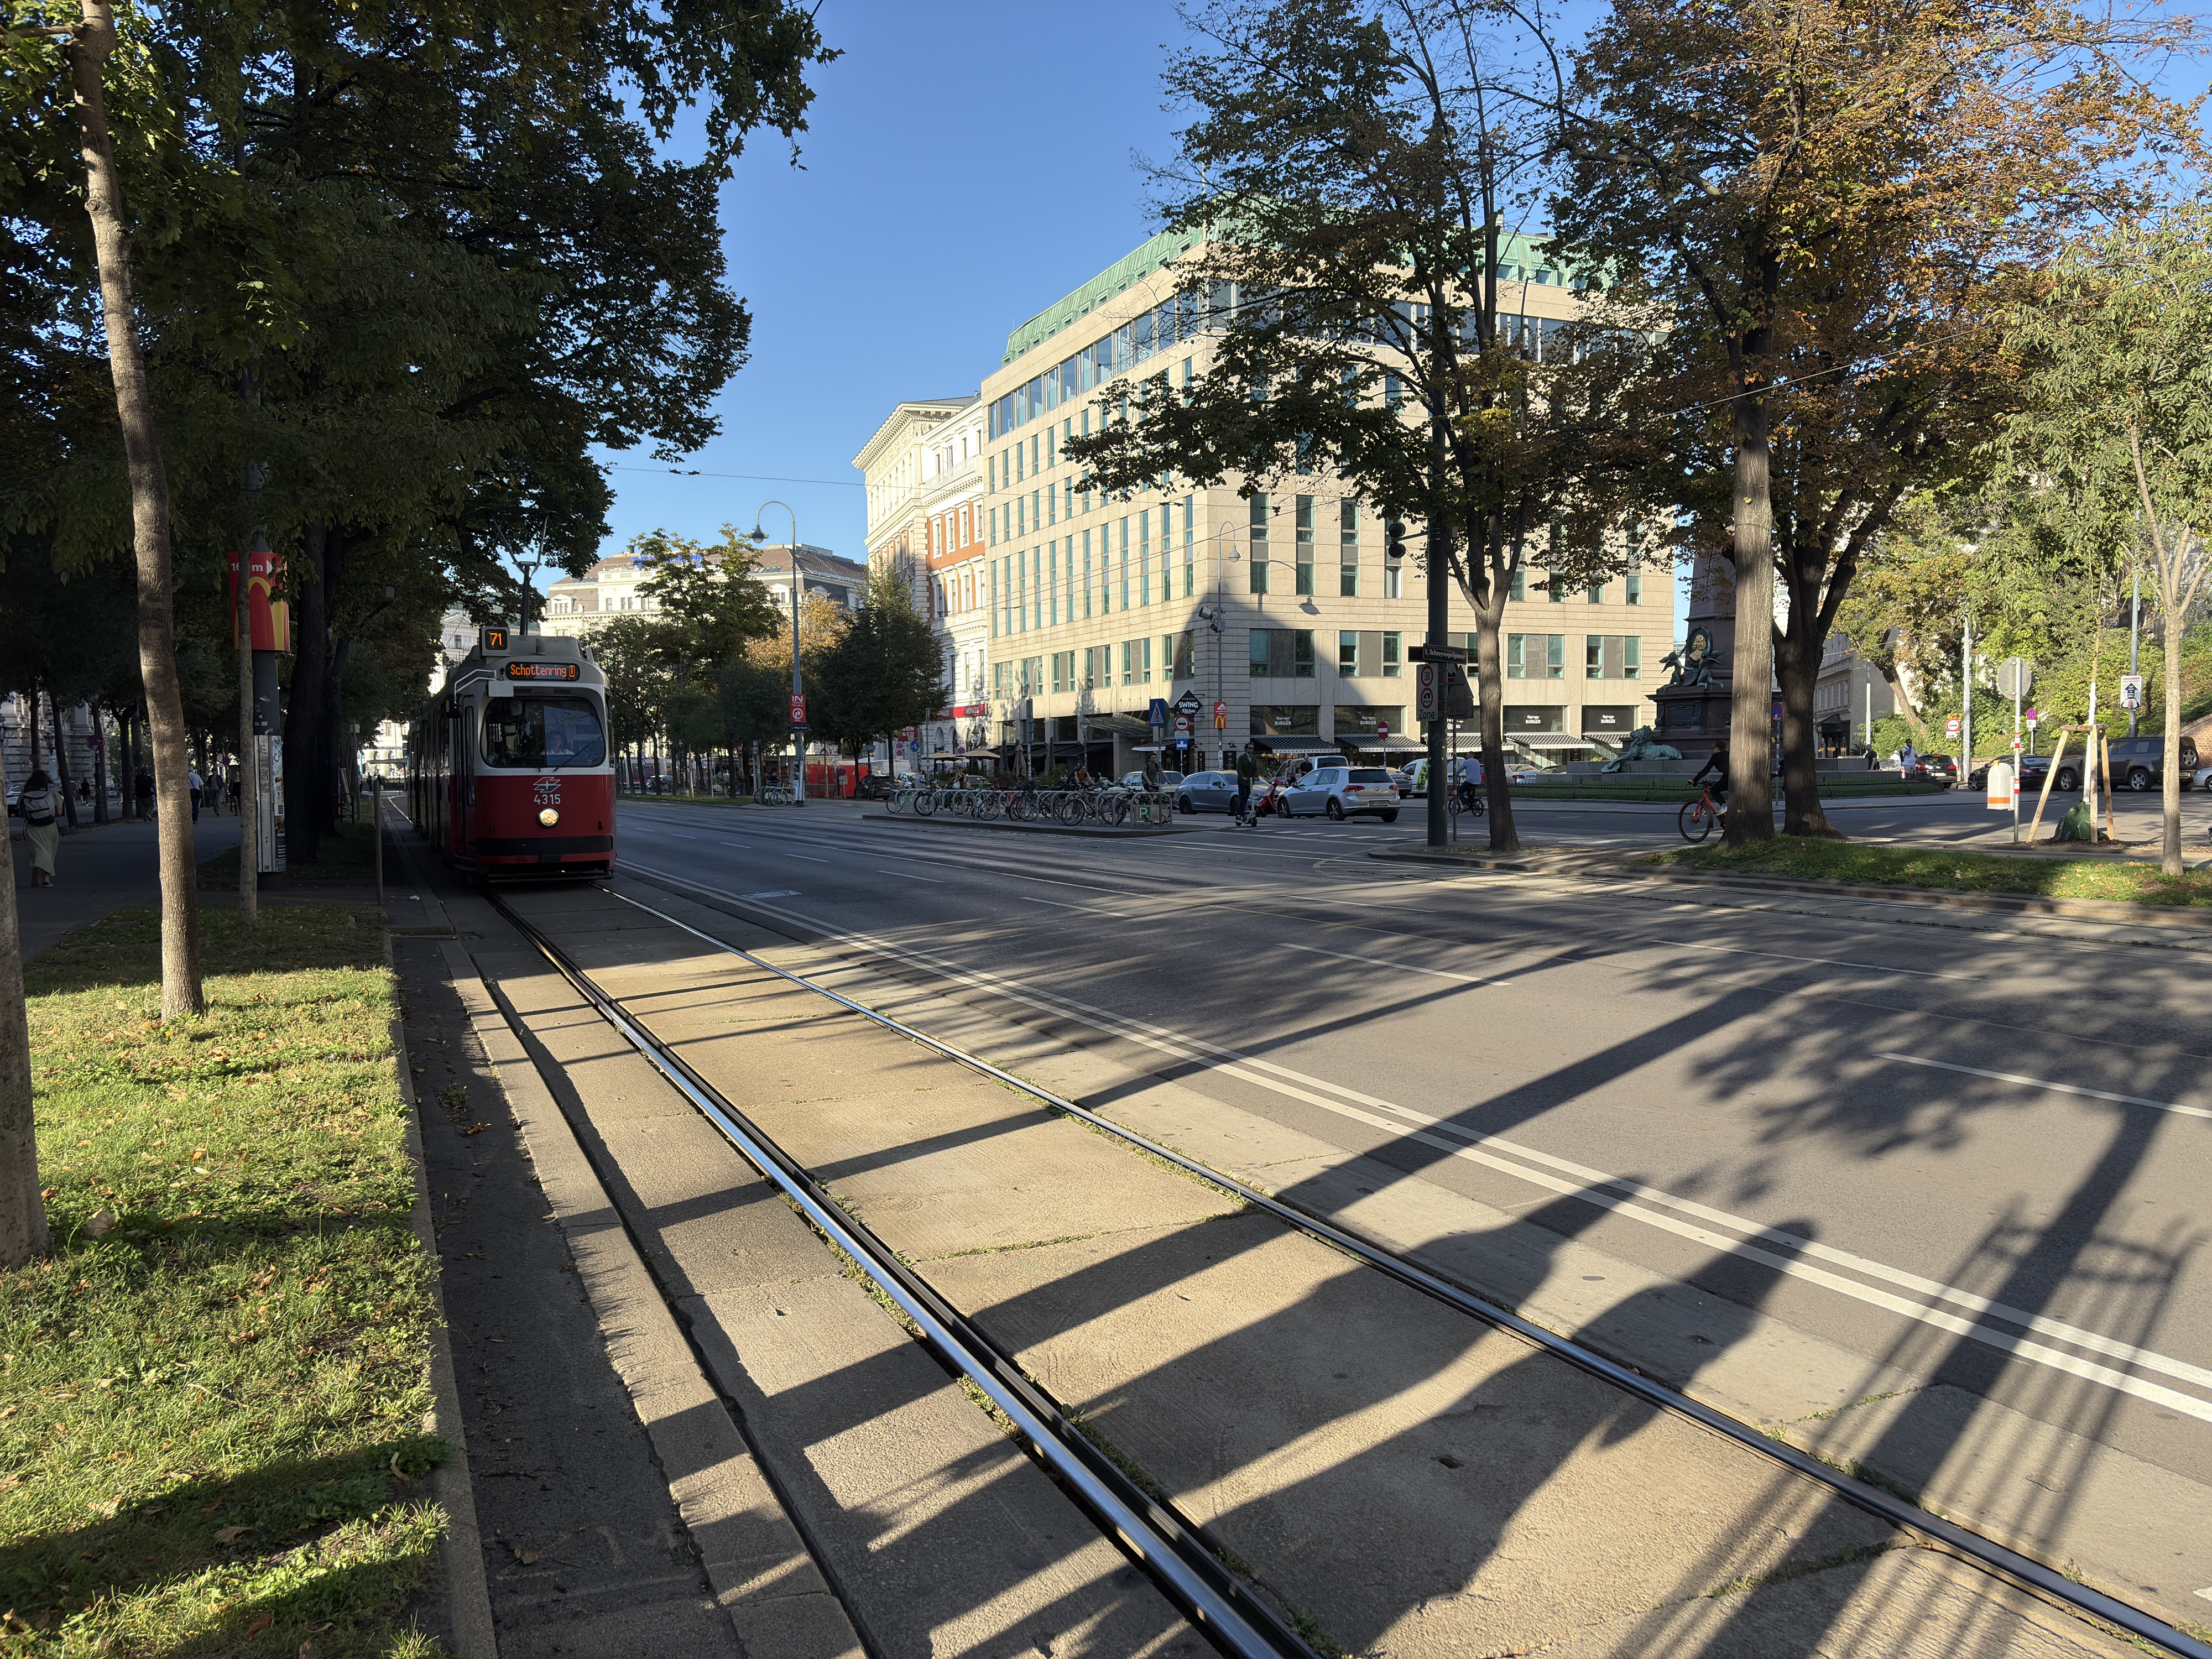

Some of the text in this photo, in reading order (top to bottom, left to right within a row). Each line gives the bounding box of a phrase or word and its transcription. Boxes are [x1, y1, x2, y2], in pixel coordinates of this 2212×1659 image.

[489, 633, 502, 646] 71
[1430, 649, 1465, 659] Schreyvogelgasse
[510, 664, 567, 677] Schottenring
[1424, 671, 1430, 681] 30
[1418, 709, 1435, 719] Zone
[534, 794, 561, 805] 4315
[1139, 807, 1147, 819] P
